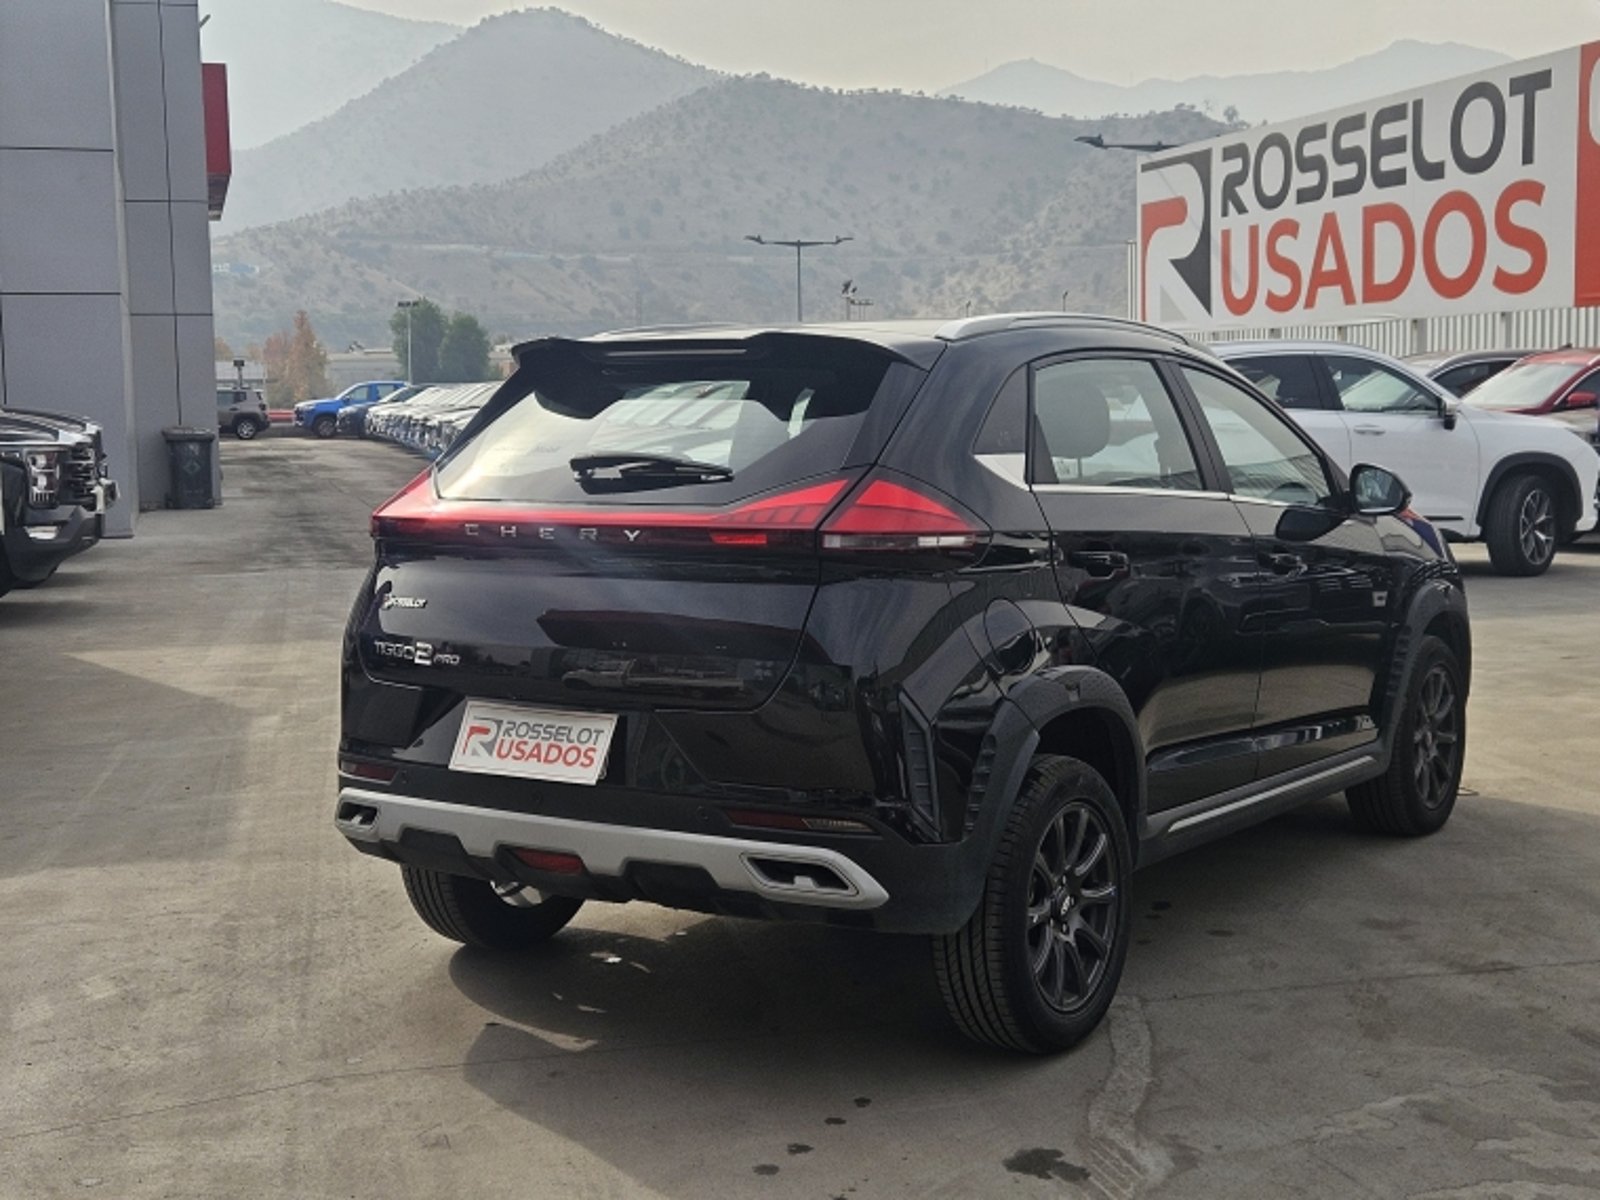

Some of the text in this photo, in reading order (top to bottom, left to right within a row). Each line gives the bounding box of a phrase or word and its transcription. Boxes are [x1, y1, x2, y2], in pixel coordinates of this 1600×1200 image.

[1221, 69, 1552, 217] ROSSELOT
[1221, 179, 1547, 316] USADOS
[465, 523, 640, 542] CHERY
[414, 641, 433, 665] 2
[433, 653, 460, 666] PRO
[502, 721, 604, 746] ROSSELOT
[496, 738, 597, 768] USADOS
